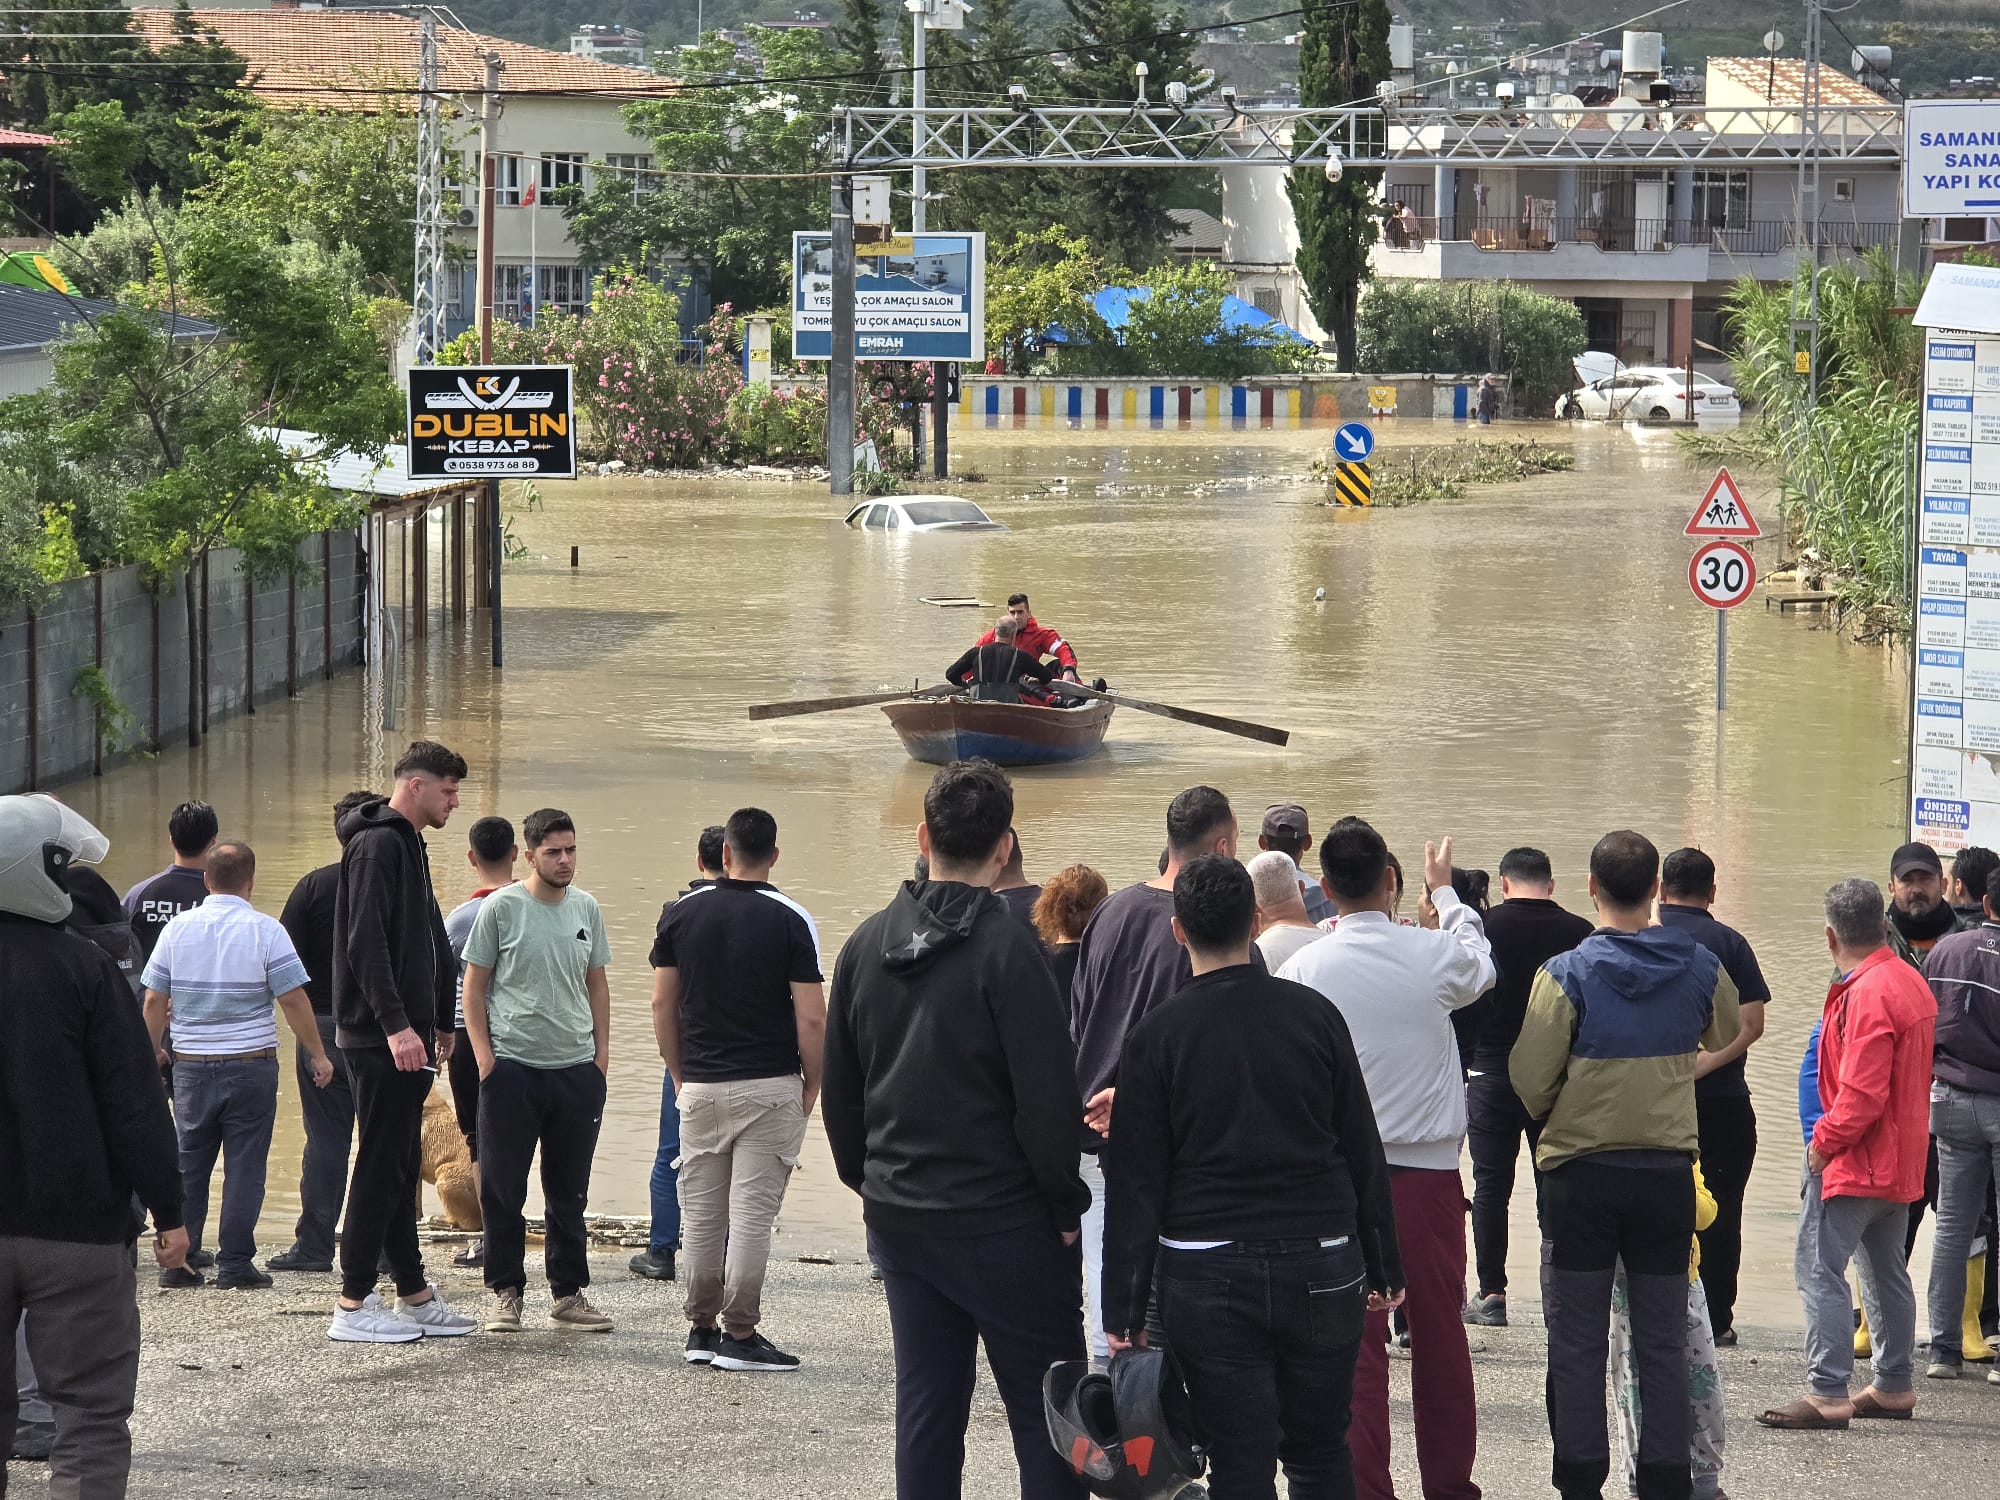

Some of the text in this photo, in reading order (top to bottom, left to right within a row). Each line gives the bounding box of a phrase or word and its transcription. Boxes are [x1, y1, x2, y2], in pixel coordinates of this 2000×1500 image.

[1920, 132, 2000, 146] SAMAN
[1945, 153, 2000, 167] SANA
[1923, 175, 1970, 189] YAPI
[861, 297, 882, 307] ÇOK
[883, 297, 920, 307] AMAÇLI
[922, 297, 954, 306] SALON
[869, 318, 890, 327] ÇOK
[891, 318, 928, 328] AMAÇLI
[930, 319, 961, 327] SALON
[859, 337, 904, 348] EMRAH
[449, 440, 530, 453] KEBAP
[459, 461, 536, 470] 0538 973 68 88
[1973, 481, 1987, 490] 0532
[1929, 499, 1966, 512] YILMAZ OTO
[1931, 551, 1957, 564] TAYAR
[1701, 556, 1744, 593] 30
[1967, 580, 1989, 588] MEHMET
[1923, 652, 1936, 663] MOR
[1920, 703, 1935, 714] UFUK
[1923, 799, 1962, 814] ÖNDER
[1918, 811, 1968, 825] MOBİLYA
